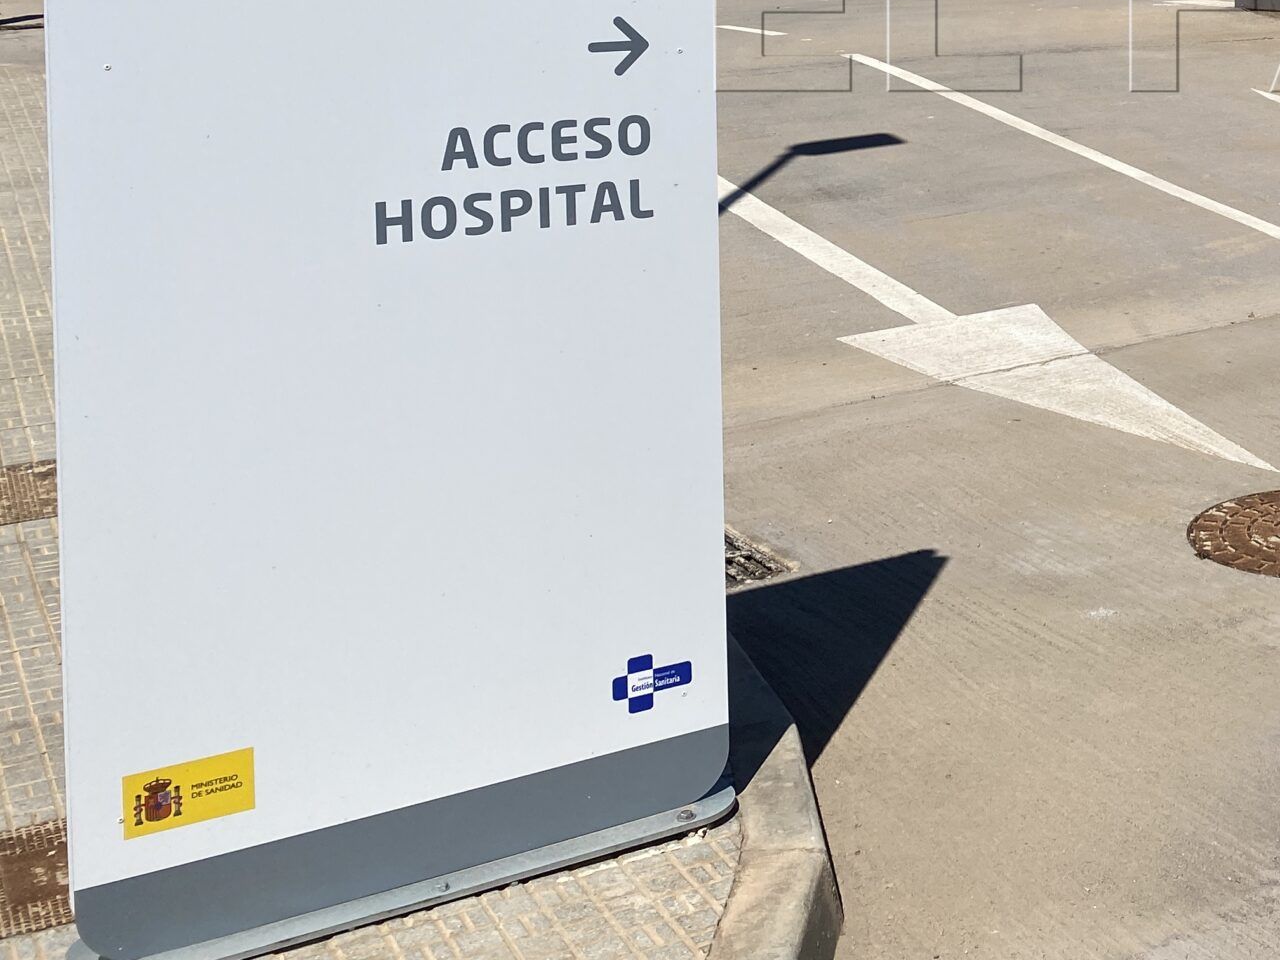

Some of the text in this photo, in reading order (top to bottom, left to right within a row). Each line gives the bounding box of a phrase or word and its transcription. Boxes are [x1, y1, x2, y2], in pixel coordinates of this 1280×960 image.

[440, 114, 652, 172] ACCESO
[374, 178, 655, 246] HOSPITAL
[655, 675, 680, 687] Sanitaria
[191, 774, 238, 790] MINISTERIO
[191, 781, 243, 798] DE SANIDAD
